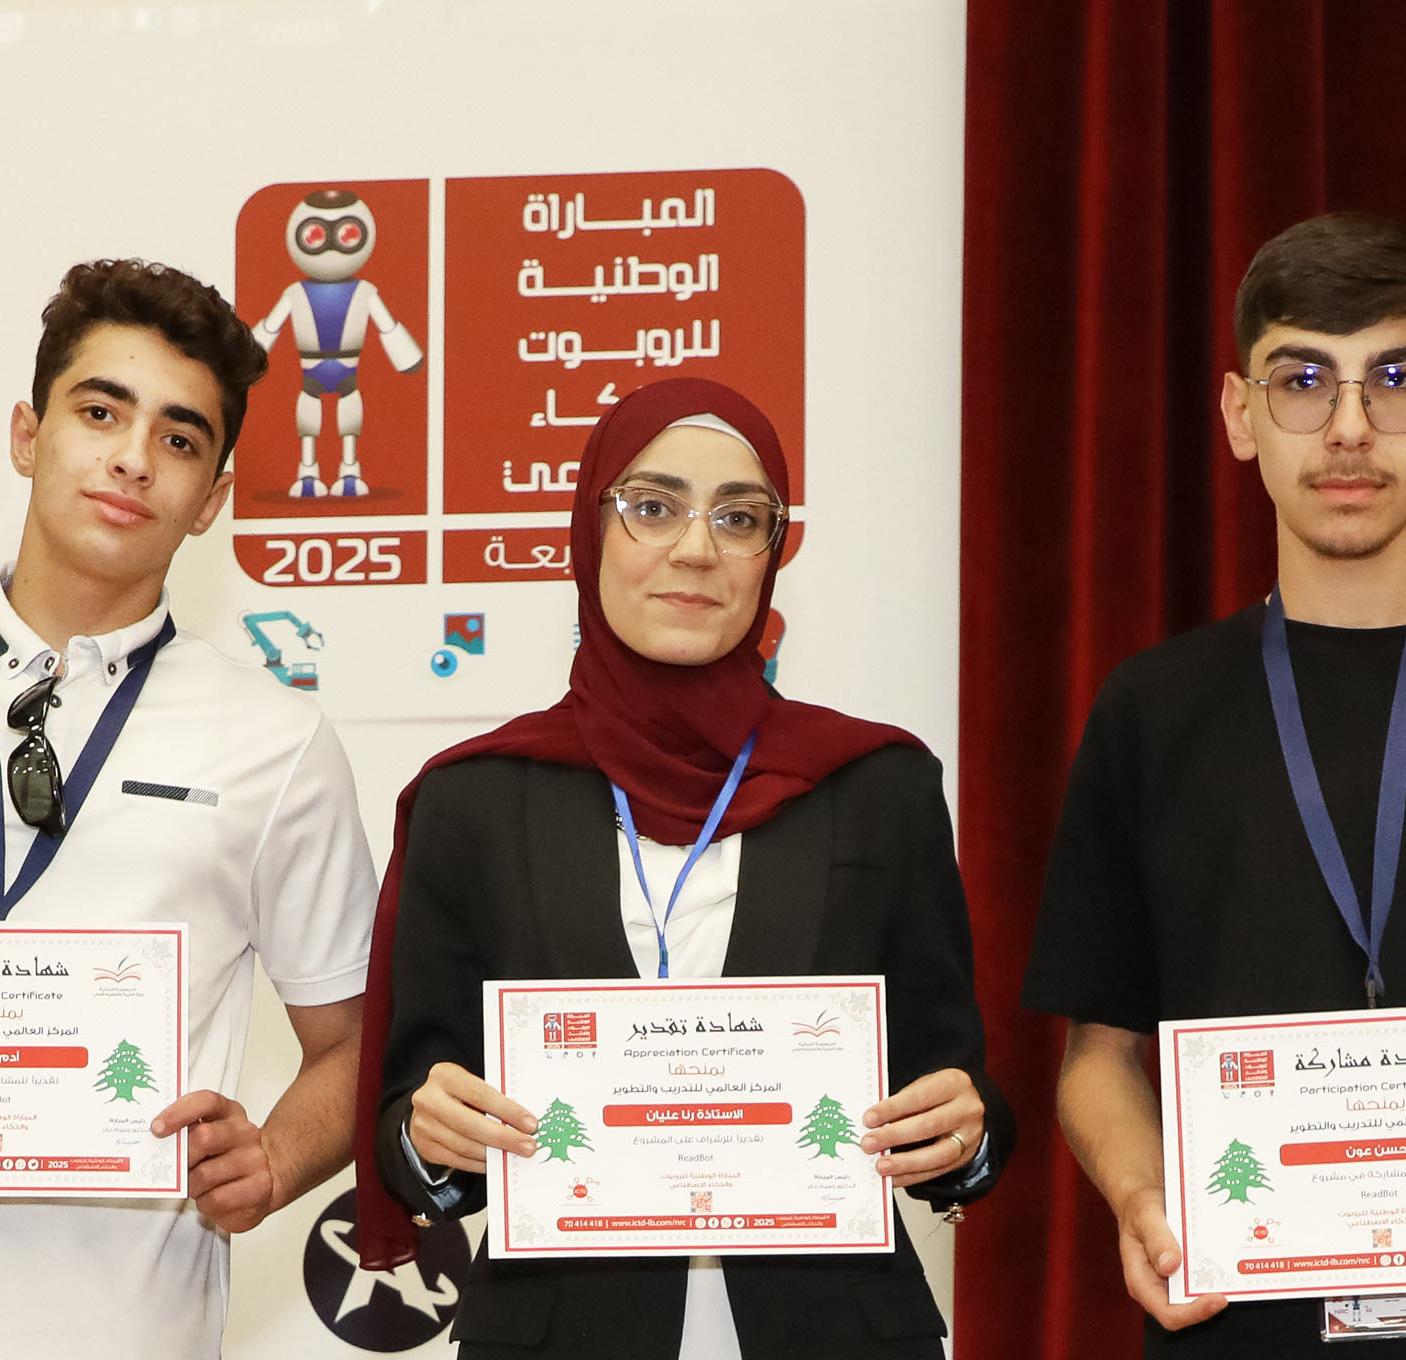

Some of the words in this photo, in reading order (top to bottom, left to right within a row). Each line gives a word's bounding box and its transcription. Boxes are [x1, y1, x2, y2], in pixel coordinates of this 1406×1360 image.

[523, 188, 715, 240] المباراة
[518, 253, 719, 303] الوطنية
[518, 319, 720, 369] للروبوت
[263, 537, 402, 583] 2025
[1, 991, 63, 1000] Certificate
[624, 1048, 698, 1058] Appreciation
[702, 1048, 764, 1056] Certificate
[1300, 1084, 1377, 1094] Participation
[678, 1154, 714, 1162] ReadBot
[1361, 1190, 1398, 1199] ReadBot
